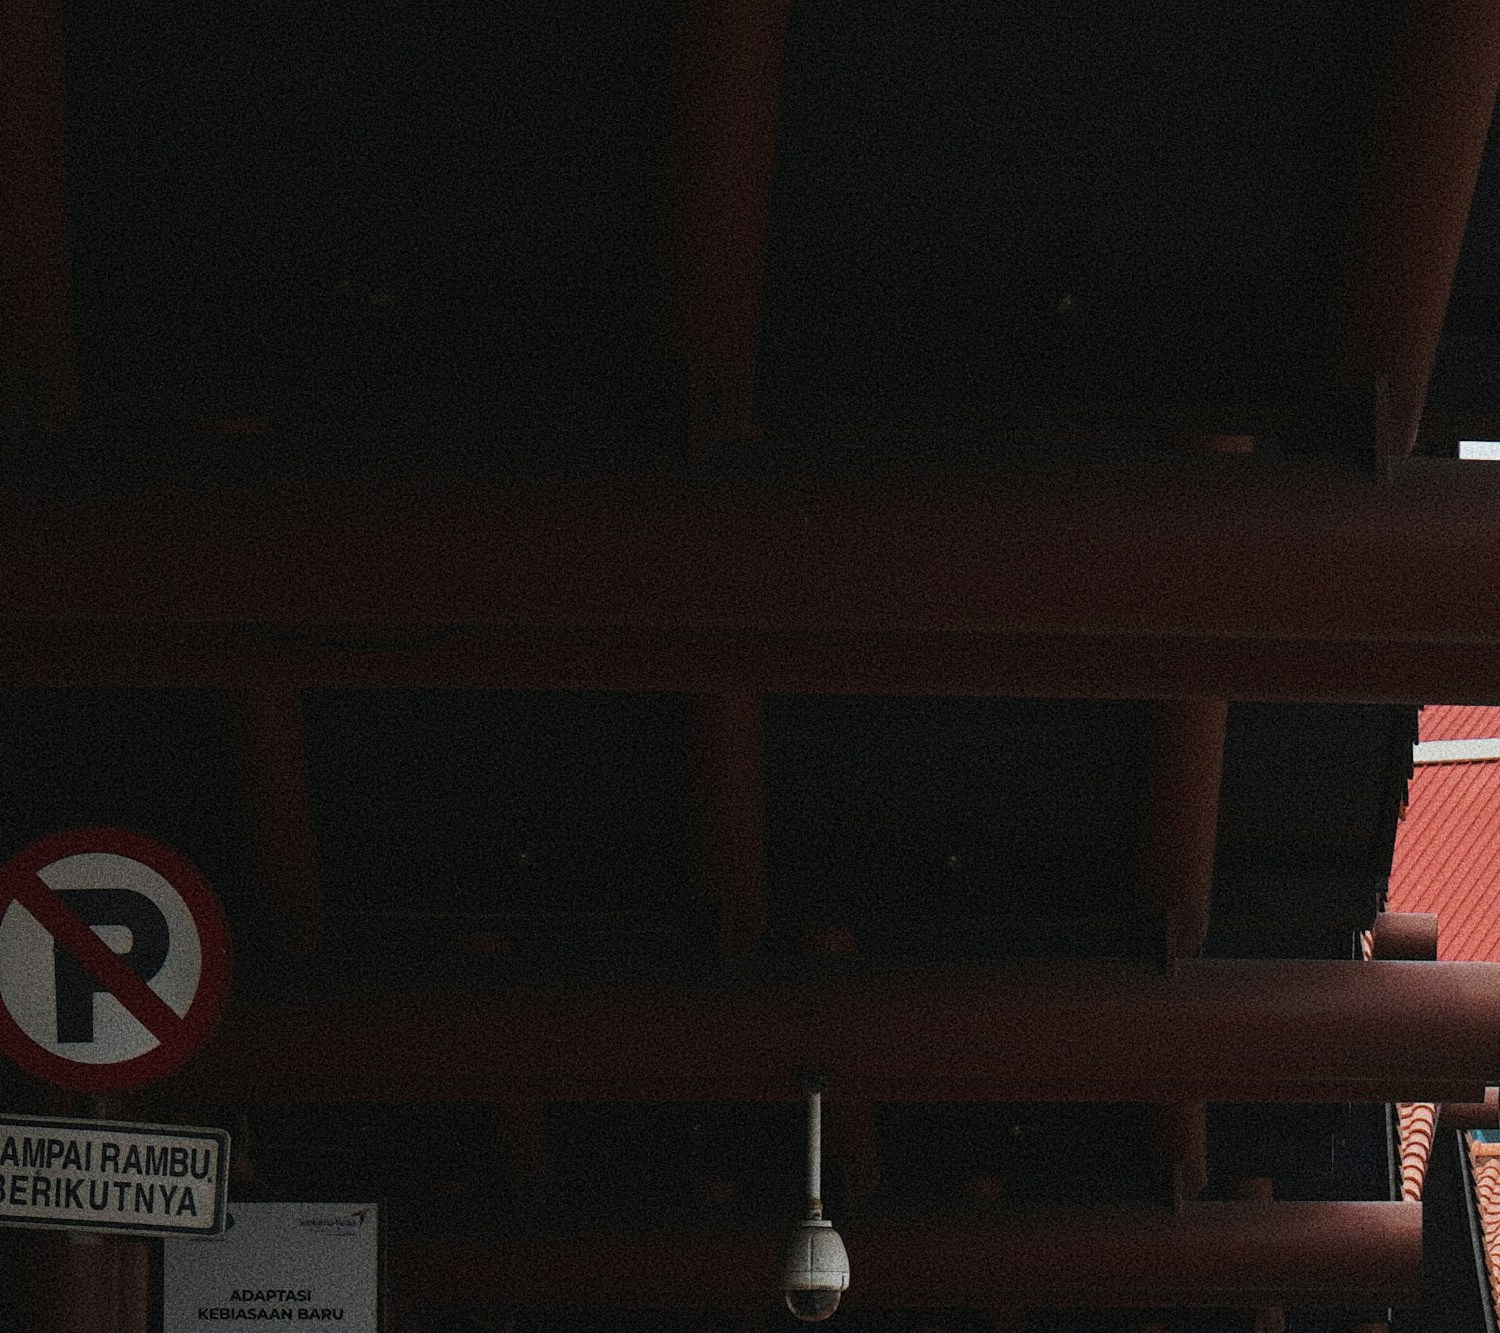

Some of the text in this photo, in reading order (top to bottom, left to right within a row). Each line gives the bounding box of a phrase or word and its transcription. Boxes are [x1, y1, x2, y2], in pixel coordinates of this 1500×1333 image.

[0, 1136, 210, 1180] AMPAI RAMBU
[230, 1289, 312, 1302] ADAPTASI
[198, 1308, 345, 1321] KEBIASAAN BARU
